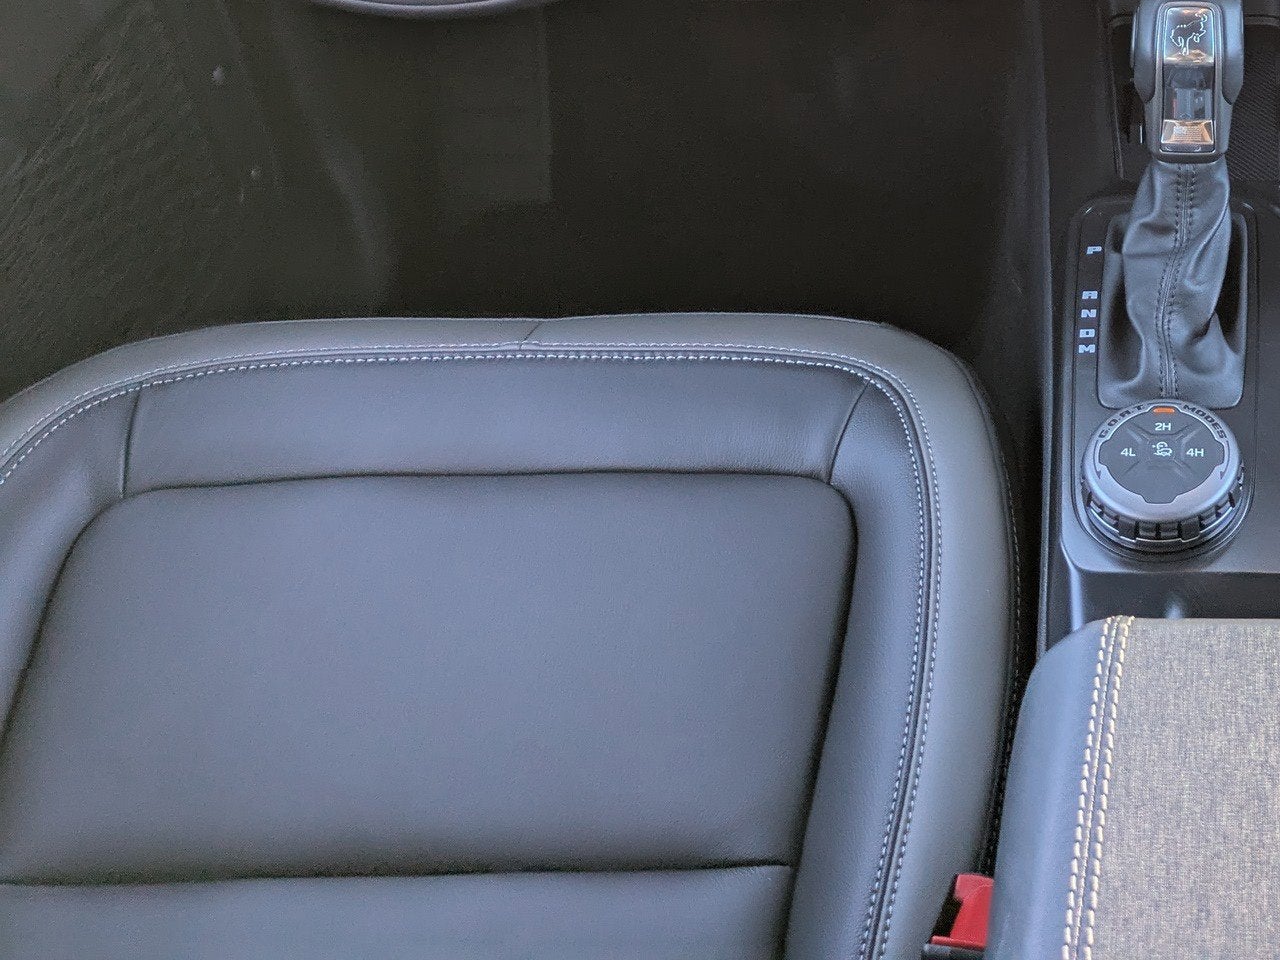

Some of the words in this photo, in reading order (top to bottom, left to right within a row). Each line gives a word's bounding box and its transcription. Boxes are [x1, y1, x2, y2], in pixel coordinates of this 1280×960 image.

[1086, 246, 1102, 255] P
[1081, 309, 1097, 318] N
[1078, 344, 1096, 353] M
[1183, 404, 1228, 439] MODES
[1155, 423, 1171, 431] 2H
[1186, 449, 1204, 457] 4H
